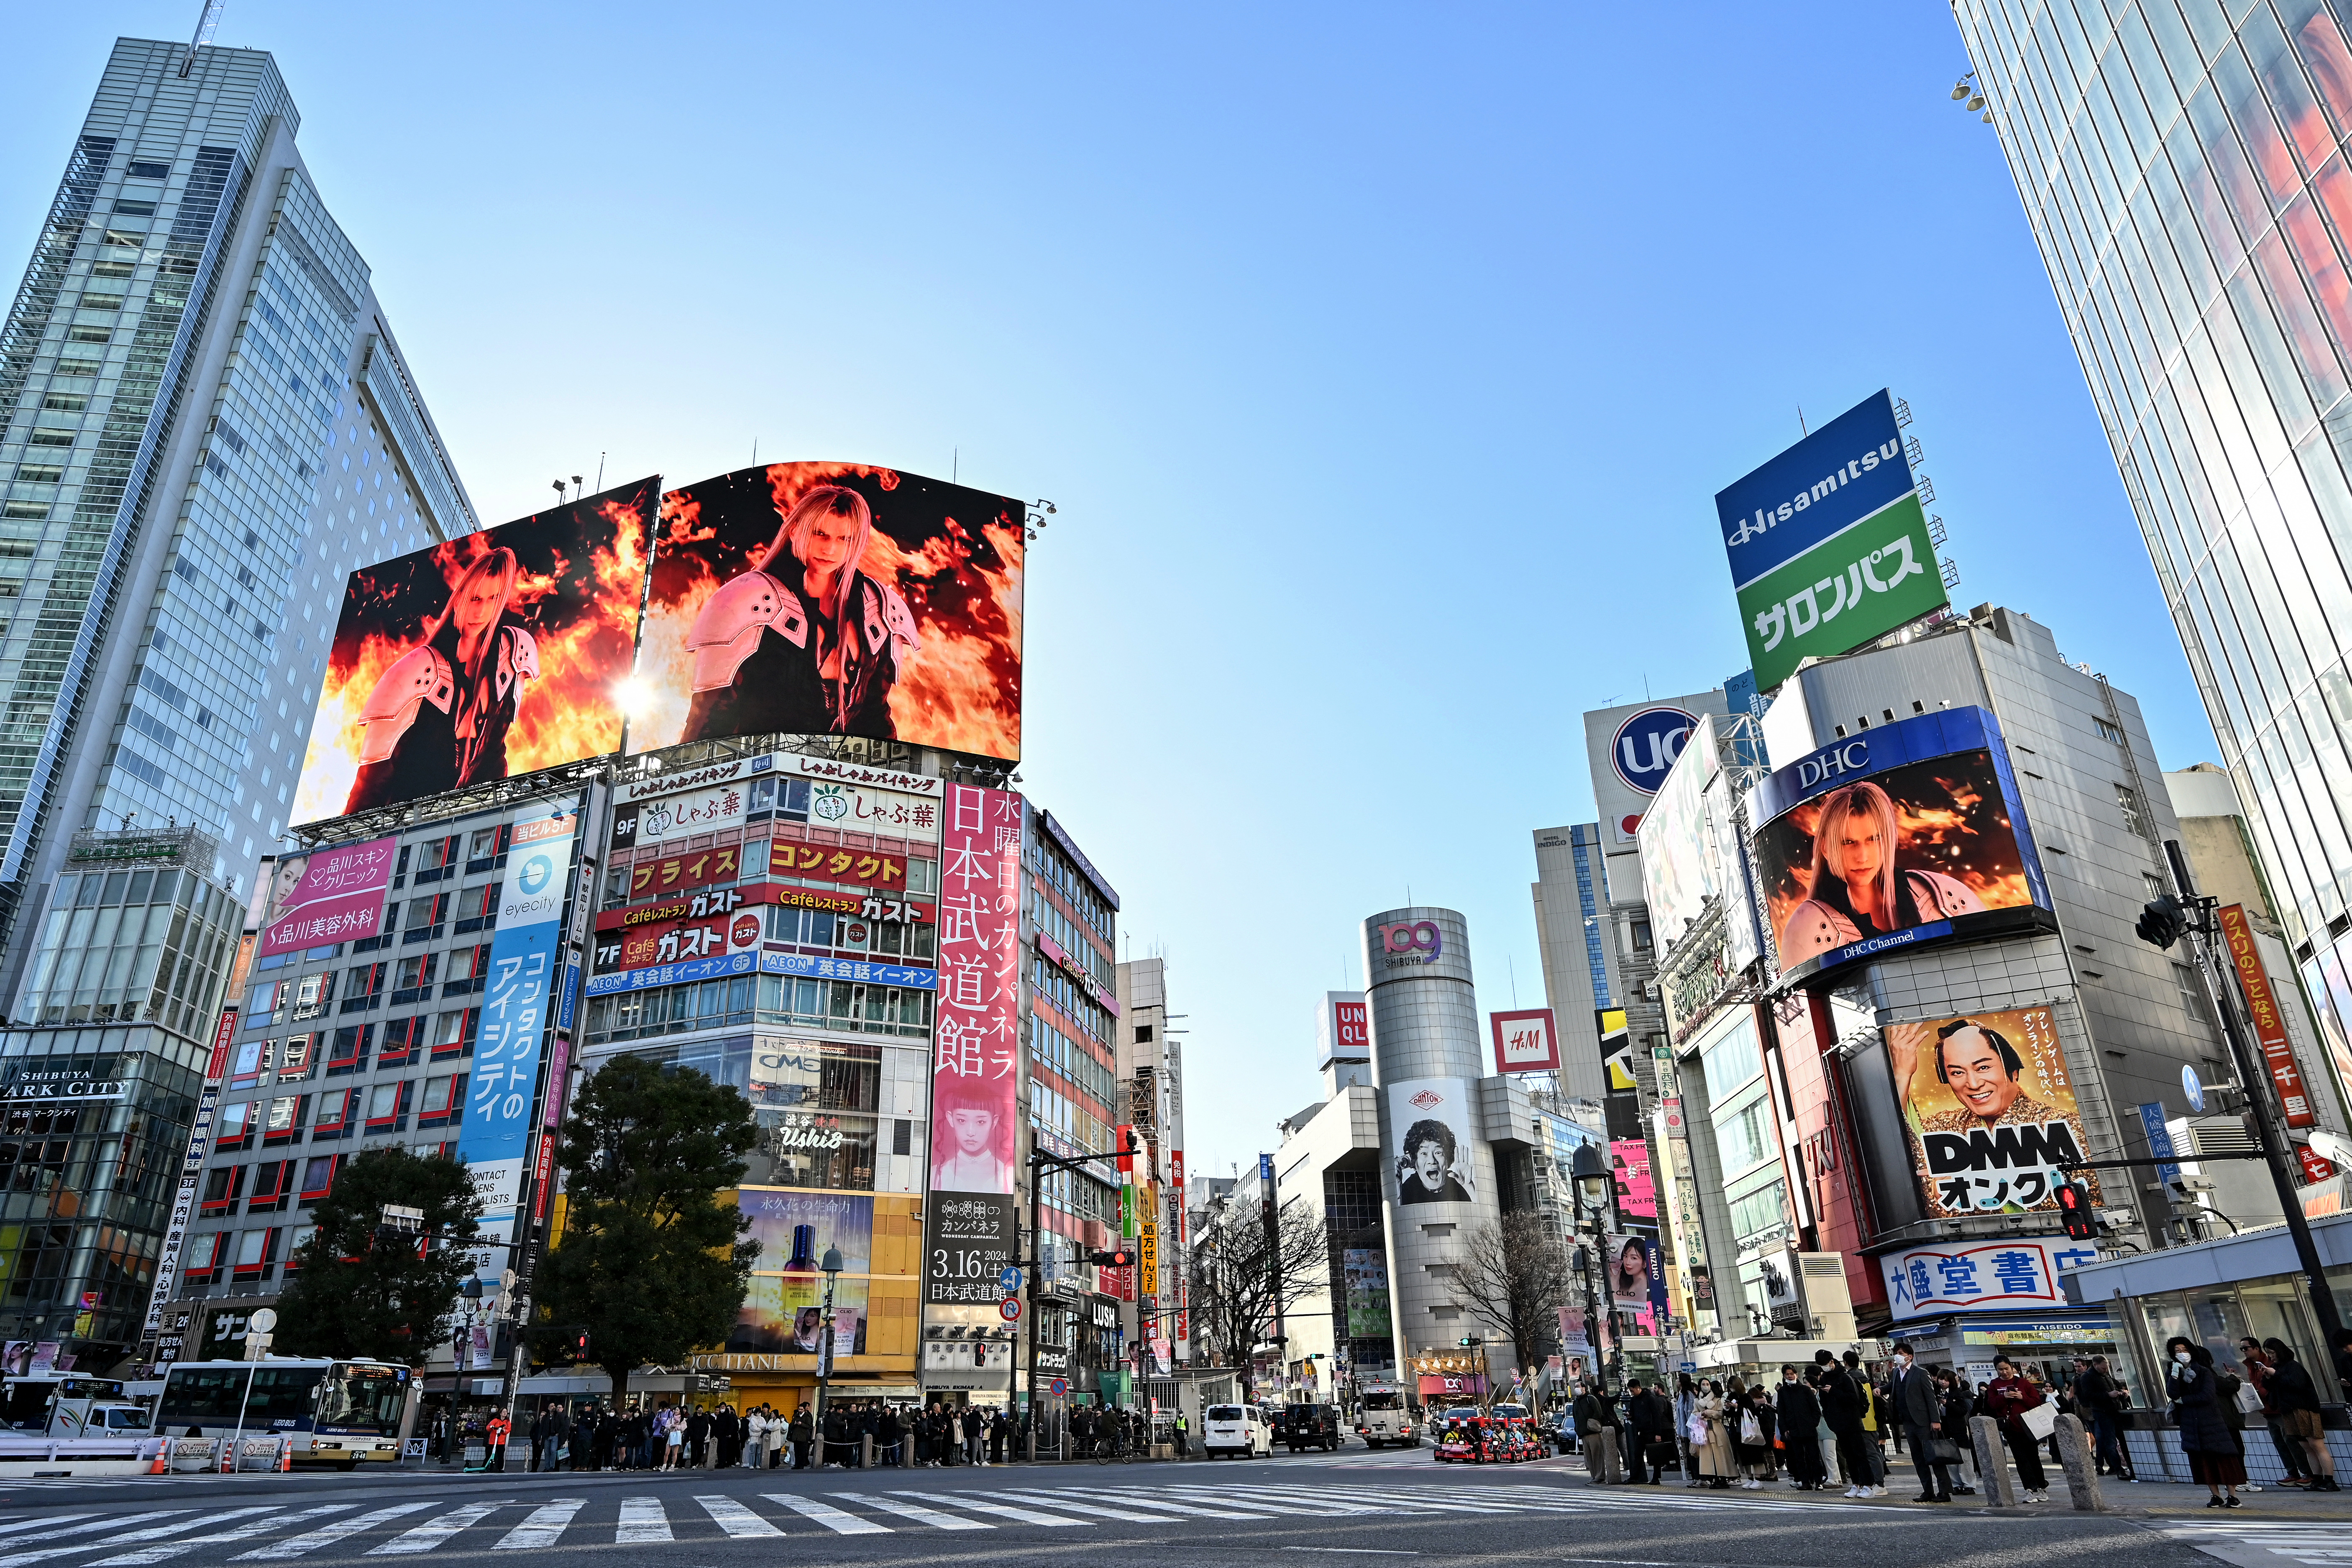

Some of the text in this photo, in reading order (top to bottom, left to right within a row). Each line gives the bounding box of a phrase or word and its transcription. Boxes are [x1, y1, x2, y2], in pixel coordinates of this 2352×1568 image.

[1728, 438, 1900, 547] Hisamitsu
[1754, 534, 1924, 652] サロンパス
[629, 756, 770, 797] しゃぶしゃぶバイキング 寿司
[801, 757, 936, 792] しゃぶしゃぶバイキング
[1796, 740, 1869, 790] DHC
[676, 791, 741, 825] しゃぶ葉
[855, 795, 934, 828] しゃぶ葉
[516, 816, 571, 842] 当ビル5F
[616, 817, 637, 835] 9F
[132, 843, 179, 854] CITY
[1538, 839, 1566, 848] INDIGO
[327, 847, 388, 873] 品川スキン
[635, 849, 736, 891] プライス
[772, 844, 902, 882] コンタクト
[323, 867, 378, 892] クリニック
[505, 895, 556, 920] eyecity
[576, 883, 589, 934] 献血ルーム
[689, 889, 741, 918] ガスト
[861, 898, 921, 923] ガスト
[278, 907, 374, 945] 品川美容外科
[735, 928, 757, 940] ガスト
[935, 785, 993, 1078] 日本武道館
[988, 792, 1021, 1080] 水曜日のカンパネラ
[598, 944, 621, 965] 7F
[627, 939, 655, 956] Café
[657, 926, 722, 963] ガスト
[1378, 921, 1442, 963] 109
[1843, 929, 1915, 959] DHC Channel
[626, 952, 652, 964] レストラン
[767, 955, 934, 985] AEON 英会話イーオン
[1385, 955, 1421, 968] SHIBUYA
[2224, 910, 2275, 1028] クスリのことなら
[231, 946, 250, 998] 東京スター銀行
[589, 975, 622, 992] AEON
[631, 959, 727, 988] 英会話イーオン
[562, 967, 576, 1026] コンタクトのアイシティ
[218, 1013, 234, 1049] 外貨両替
[474, 957, 525, 1123] アイシティ
[502, 952, 546, 1119] コンタクトの
[1509, 1029, 1540, 1051] H&M
[2022, 1012, 2057, 1101] オンラインの時代へ。
[2037, 1011, 2066, 1086] クレーンゲームは
[20, 1071, 90, 1081] SHIBUYA
[549, 1055, 563, 1113] 品川美容外科
[2264, 1037, 2309, 1117] 三千里
[0, 1082, 127, 1097] ARK CITY
[1413, 1092, 1438, 1104] DANTON
[189, 1095, 215, 1156] 加藤眼科
[545, 1116, 555, 1125] 4F
[539, 1136, 553, 1180] 外貨両替
[1924, 1122, 2082, 1176] DMM
[187, 1159, 200, 1168] 5F
[467, 1169, 507, 1182] CONTACT
[1173, 1159, 1182, 1179] 免税
[182, 1179, 195, 1188] 3F
[1112, 1171, 1121, 1188] 4F
[760, 1196, 851, 1214] 永久花の生命力
[1679, 1192, 1688, 1213] パーラー
[1686, 1189, 1695, 1210] フルーツ
[172, 1205, 187, 1227] 内科
[942, 1220, 1001, 1234] カンパネラ
[984, 1250, 1007, 1261] 2024
[1142, 1224, 1155, 1272] 処方せん
[1687, 1234, 1696, 1256] フルーツ
[1693, 1231, 1702, 1254] 渋谷西村
[933, 1248, 981, 1279] 3.16
[1648, 1247, 1660, 1281] MIZUHO
[932, 1283, 1007, 1302] 日本武道館
[1146, 1274, 1153, 1291] 3F
[1696, 1275, 1711, 1299] HUB
[163, 1314, 175, 1330] 薬
[1093, 1302, 1115, 1329] LUSH
[159, 1336, 183, 1347] 処方せん
[161, 1348, 176, 1360] 受付
[1042, 1352, 1067, 1368] サンドラッグ
